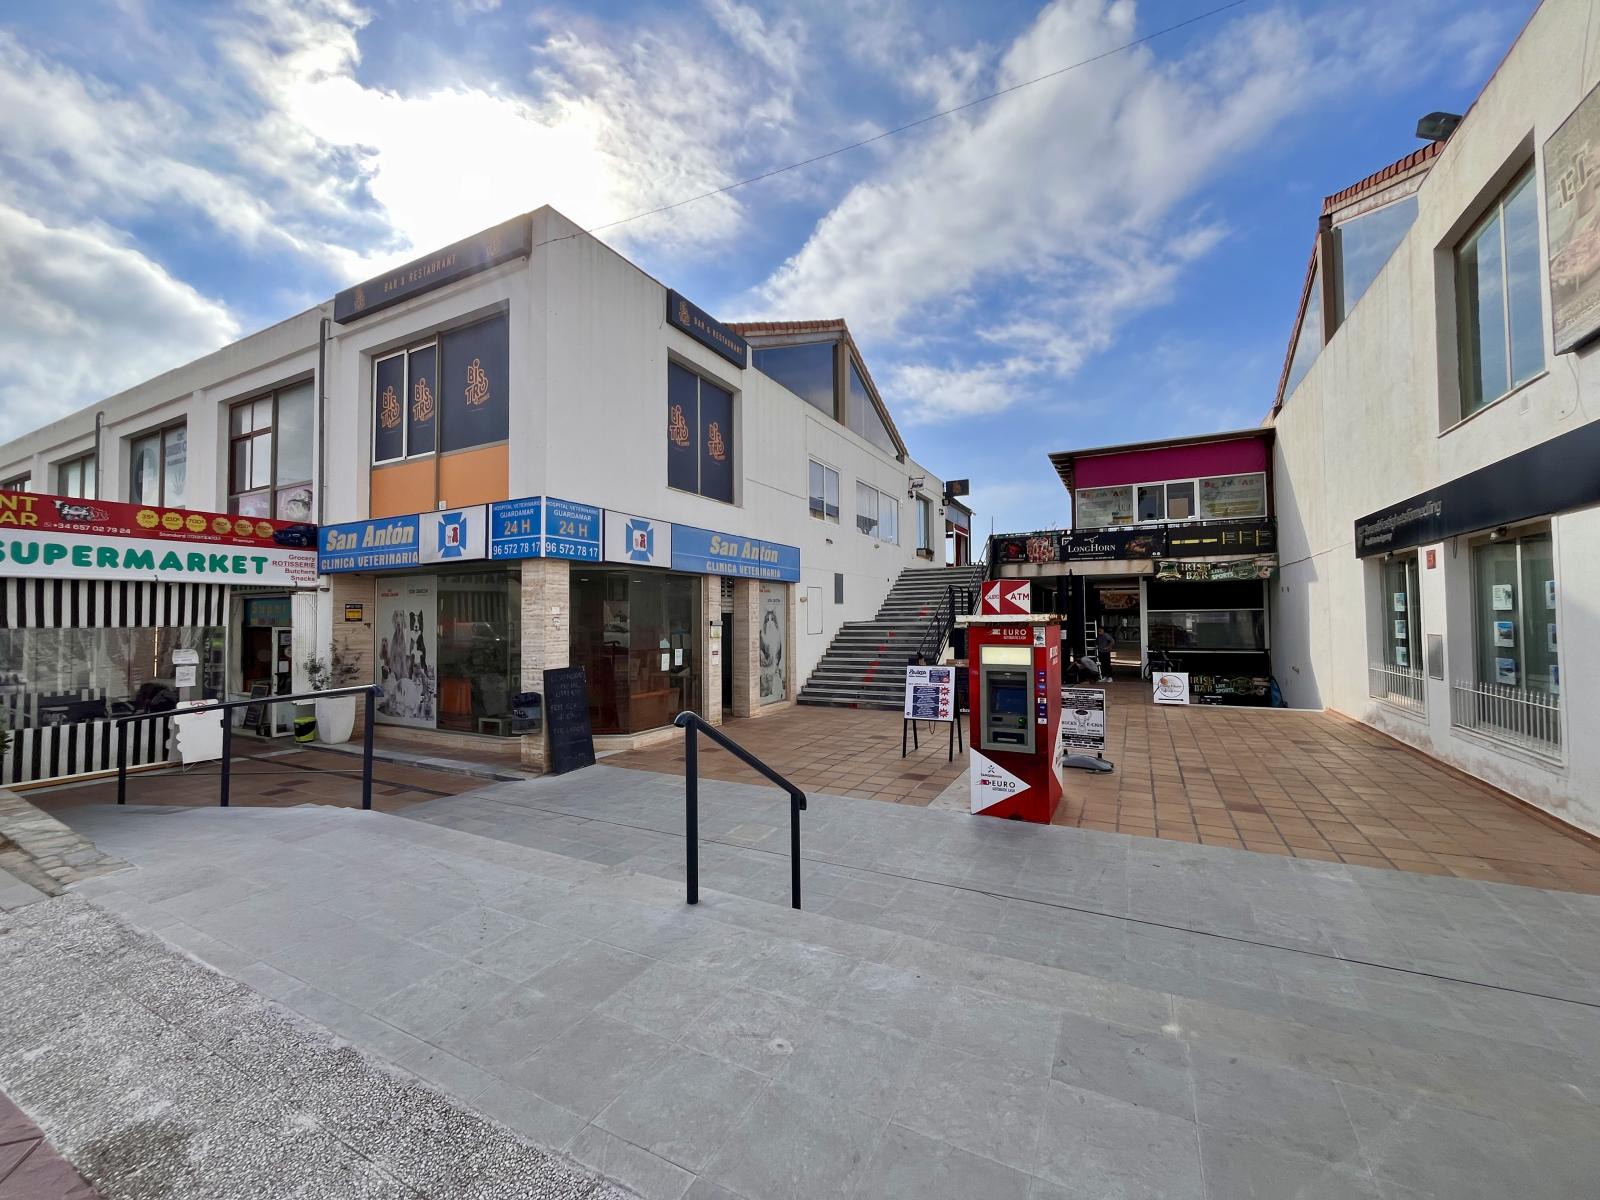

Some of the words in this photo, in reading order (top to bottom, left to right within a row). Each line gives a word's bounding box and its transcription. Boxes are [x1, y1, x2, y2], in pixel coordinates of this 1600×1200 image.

[384, 281, 398, 293] BAR
[408, 254, 457, 283] RESTAURANT
[694, 316, 705, 330] BAR
[712, 328, 743, 355] RESTAURANT
[494, 503, 512, 511] HOSPITAL
[546, 500, 569, 510] HOSPITAL
[0, 511, 38, 527] AR
[499, 508, 534, 519] GUARDAMAR
[553, 509, 591, 521] GUARDAMAR
[504, 519, 518, 535] 24
[521, 518, 531, 533] H
[559, 520, 575, 535] 24
[578, 523, 588, 537] H
[326, 530, 357, 552] San
[362, 521, 415, 548] Antón
[493, 545, 502, 555] 96
[504, 544, 517, 554] 572
[519, 543, 529, 552] 78
[531, 541, 541, 551] 17
[546, 543, 557, 553] 96
[559, 544, 575, 555] 572
[577, 546, 587, 556] 78
[589, 547, 599, 557] 17
[710, 535, 738, 556] San
[741, 541, 779, 563] Antón
[0, 540, 268, 574] UPERMARKET
[288, 554, 316, 564] Grocery
[321, 557, 354, 570] CLINICA
[358, 552, 418, 567] VETERINARIA
[272, 561, 316, 569] ROTISSERIE
[706, 561, 738, 574] CLINICA
[739, 563, 781, 578] VETERINARIA
[1181, 562, 1211, 571] IRISH
[284, 567, 316, 576] Butchers
[1186, 570, 1208, 580] BAR
[1211, 571, 1233, 580] SPORTS
[1010, 593, 1029, 601] ATM
[1003, 628, 1027, 636] EURO
[1190, 676, 1215, 684] IRISH
[1194, 684, 1213, 693] BAR
[992, 780, 1015, 788] EURO
